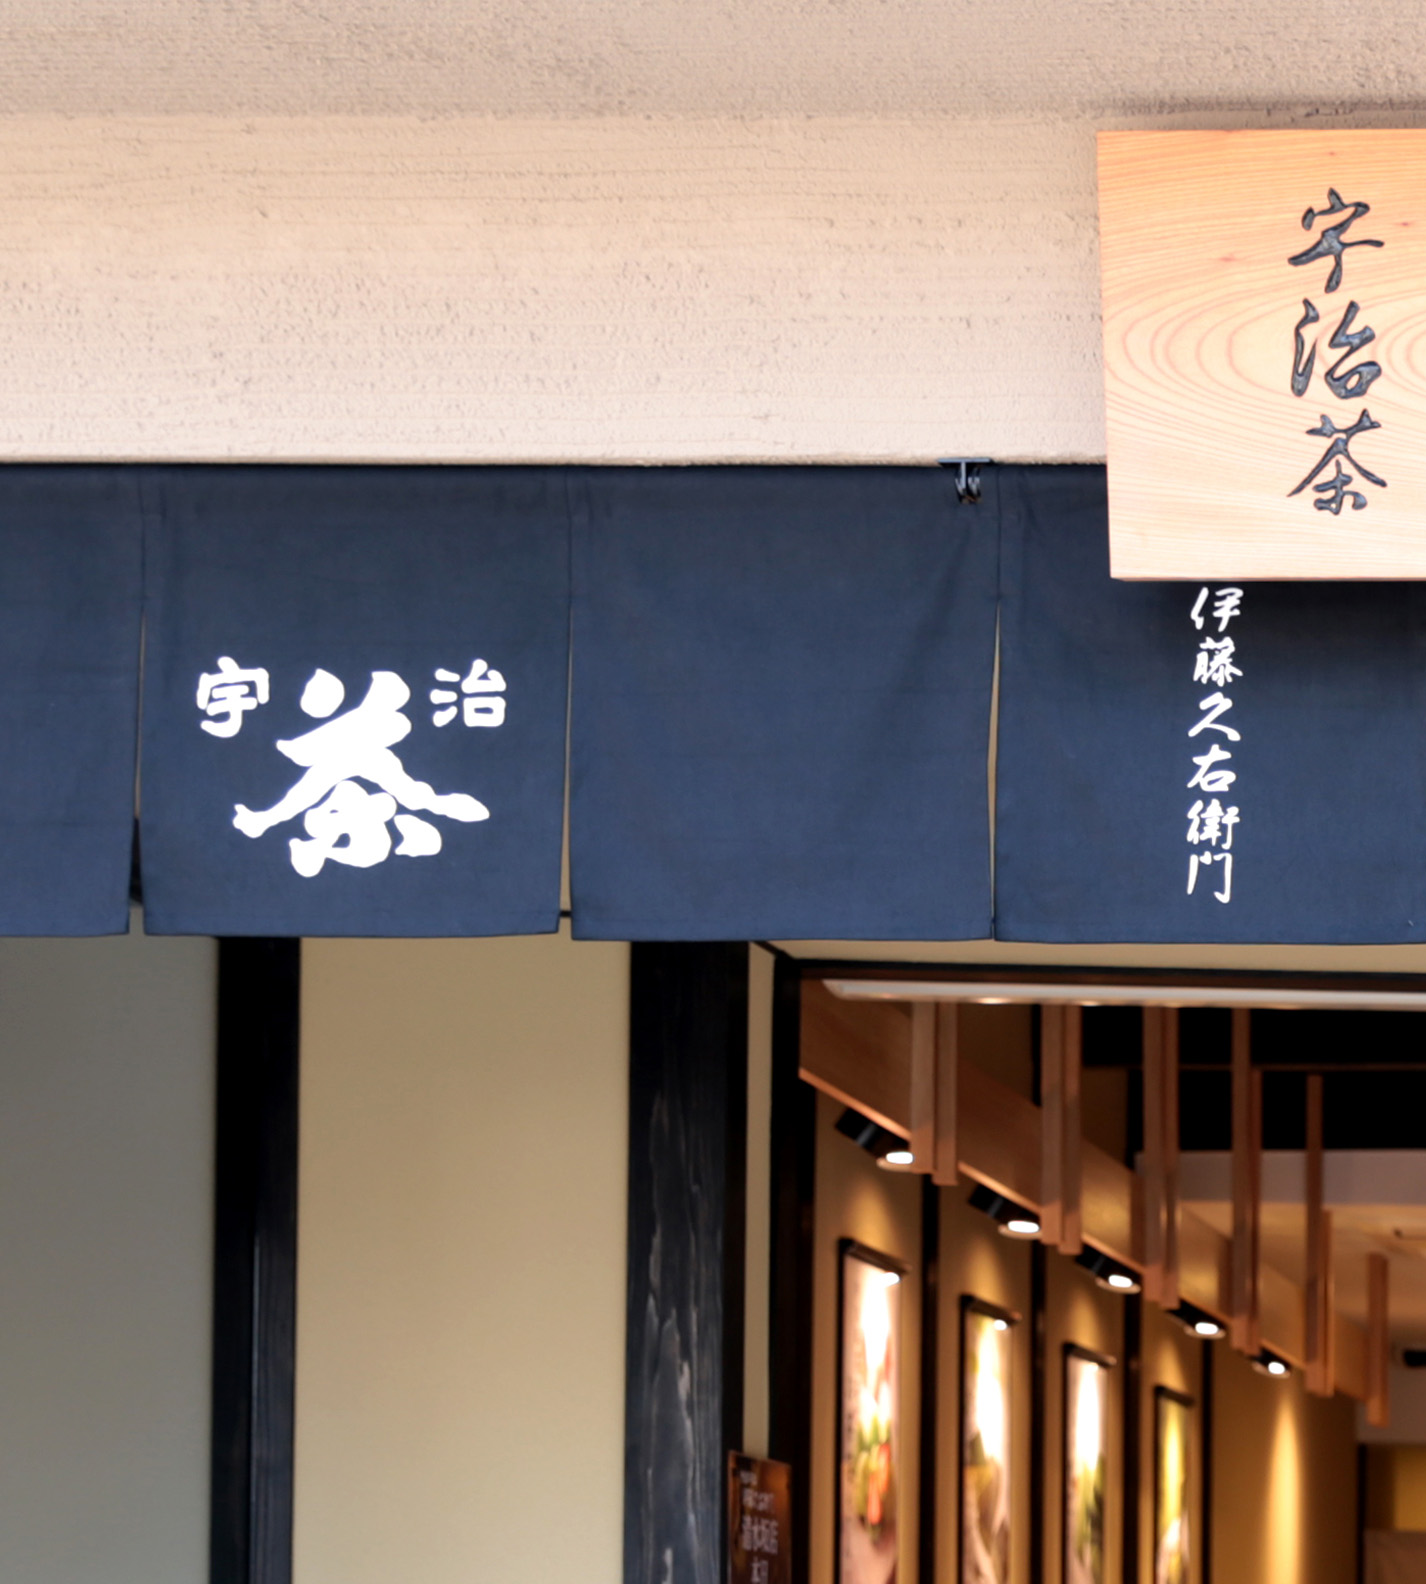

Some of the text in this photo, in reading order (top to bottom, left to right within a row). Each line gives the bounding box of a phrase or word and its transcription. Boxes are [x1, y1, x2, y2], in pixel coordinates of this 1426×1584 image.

[1288, 188, 1387, 515] 宇治茶
[1187, 588, 1243, 903] 伊藤久右衛門
